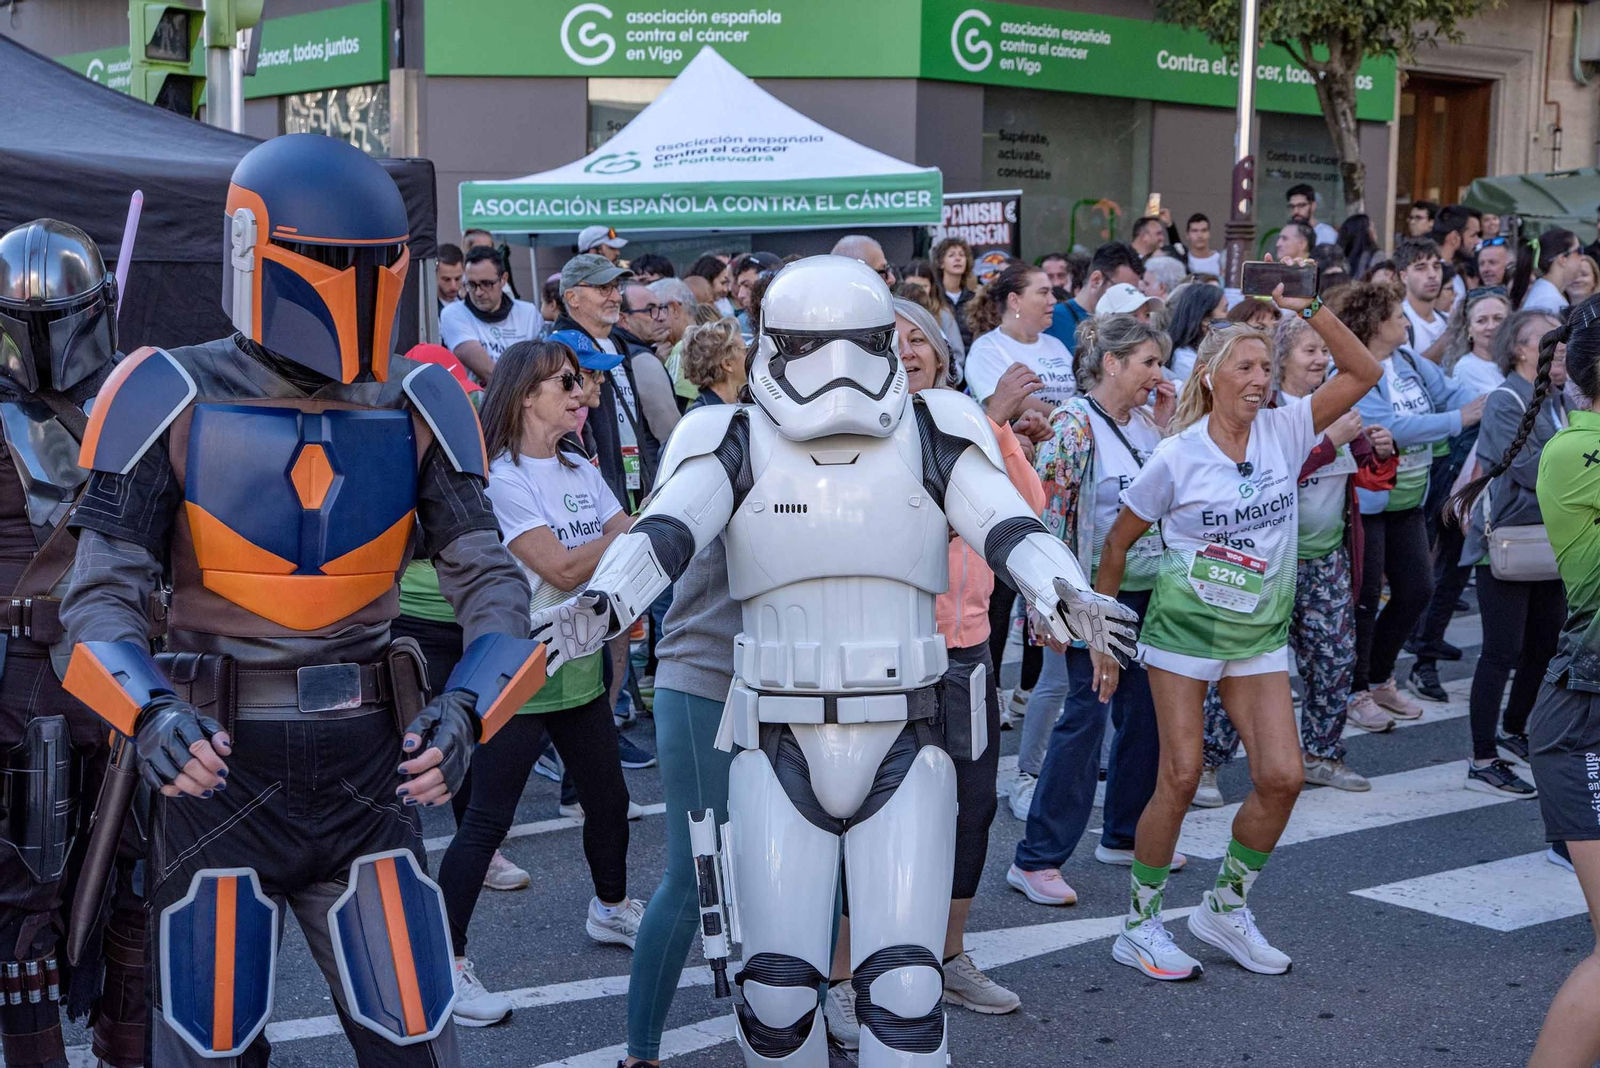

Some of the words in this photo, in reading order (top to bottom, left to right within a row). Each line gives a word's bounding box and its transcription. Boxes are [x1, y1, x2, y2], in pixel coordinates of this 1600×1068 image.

[626, 9, 707, 25] asociación
[711, 9, 782, 27] española
[626, 29, 676, 43] contra
[679, 28, 693, 43] el
[696, 28, 750, 43] cáncer
[1000, 21, 1060, 39] asociación
[1061, 28, 1111, 45] española
[293, 41, 324, 62] todos
[324, 36, 360, 61] juntos
[626, 49, 646, 61] en
[648, 47, 683, 64] Vigo
[1000, 39, 1037, 55] contra
[1038, 41, 1049, 55] el
[1050, 43, 1089, 60] cáncer
[999, 57, 1015, 71] en
[1015, 57, 1042, 76] Vigo
[1156, 50, 1209, 74] Contra
[1212, 55, 1227, 76] el
[655, 135, 743, 152] asociación
[748, 134, 824, 145] española
[712, 145, 727, 153] el
[731, 145, 789, 153] cáncer
[471, 194, 602, 216] ASOCIACIÓN
[607, 193, 719, 215] ESPAÑOLA
[722, 195, 811, 213] CONTRA
[815, 194, 841, 211] EL
[845, 189, 932, 210] CÁNCER
[942, 201, 1003, 226] PANISH
[1202, 511, 1228, 526] En
[1208, 565, 1247, 587] 3216
